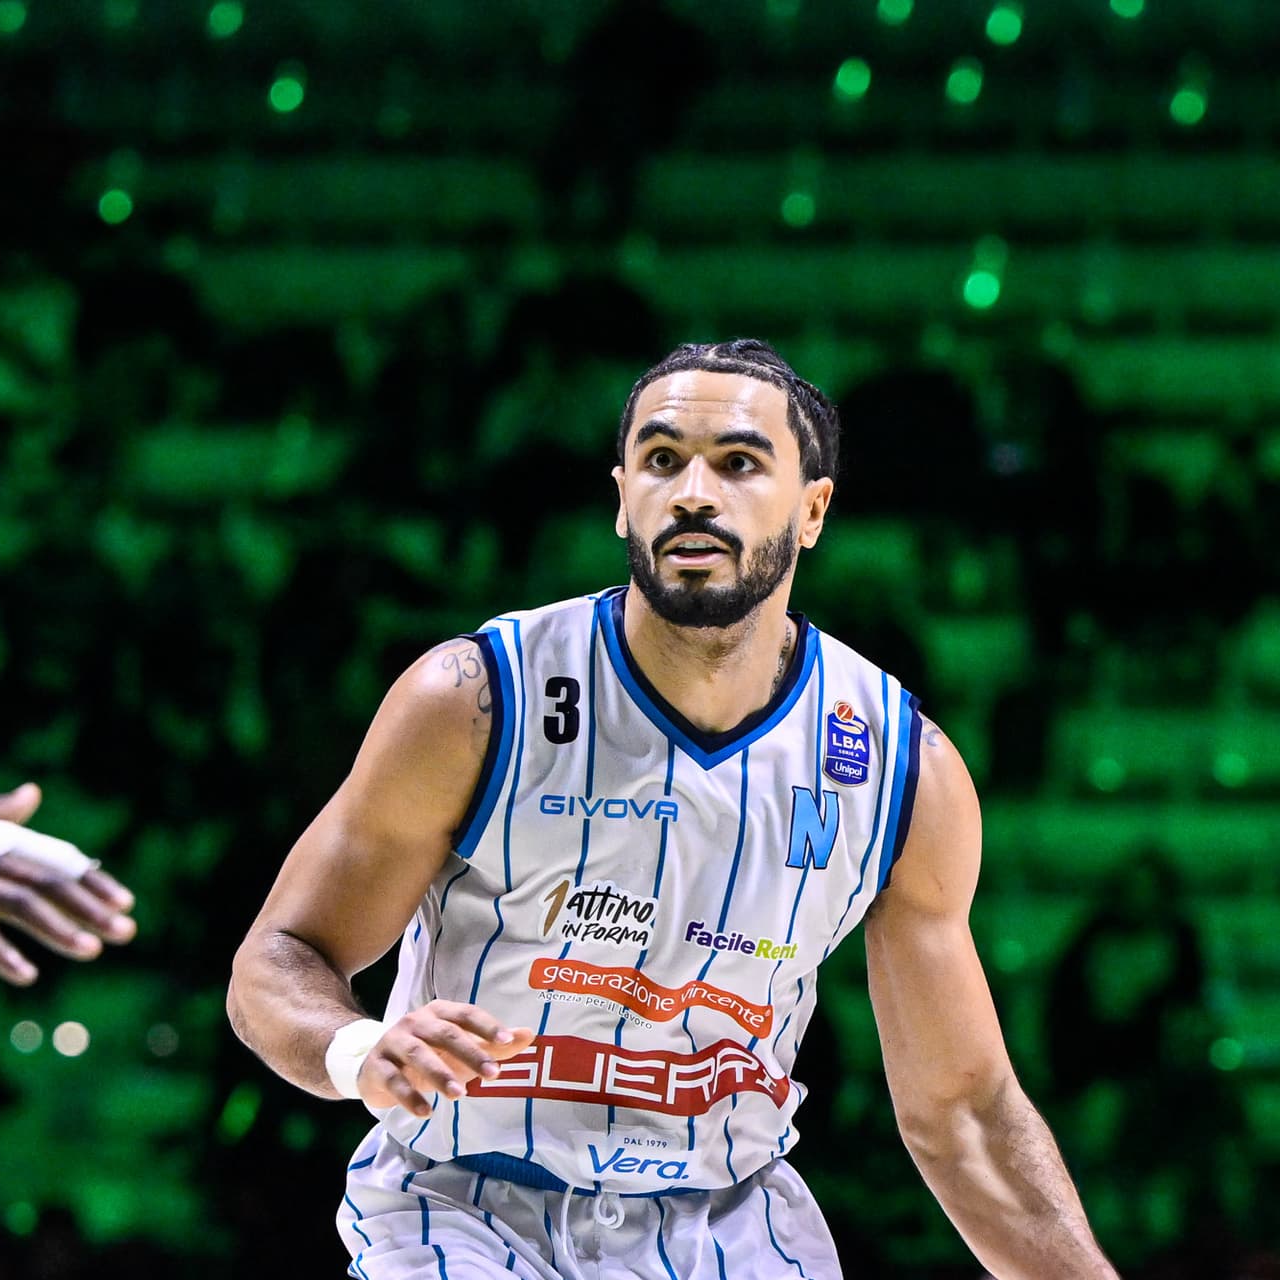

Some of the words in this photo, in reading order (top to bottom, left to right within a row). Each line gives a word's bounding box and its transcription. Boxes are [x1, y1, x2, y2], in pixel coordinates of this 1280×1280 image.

[543, 676, 581, 744] 3
[832, 733, 866, 752] LBA
[835, 761, 863, 777] Unipol
[540, 795, 678, 822] GIVOVA
[785, 786, 840, 870] N
[581, 922, 650, 946] FORMA
[684, 921, 798, 960] FacileRent
[538, 991, 582, 1003] Agenzia
[585, 996, 606, 1008] per
[608, 1002, 615, 1012] il
[618, 1007, 653, 1029] Lavoro
[543, 965, 676, 1012] generazione
[681, 984, 767, 1029] vincente
[623, 1137, 643, 1147] DAL
[646, 1139, 668, 1149] 1979
